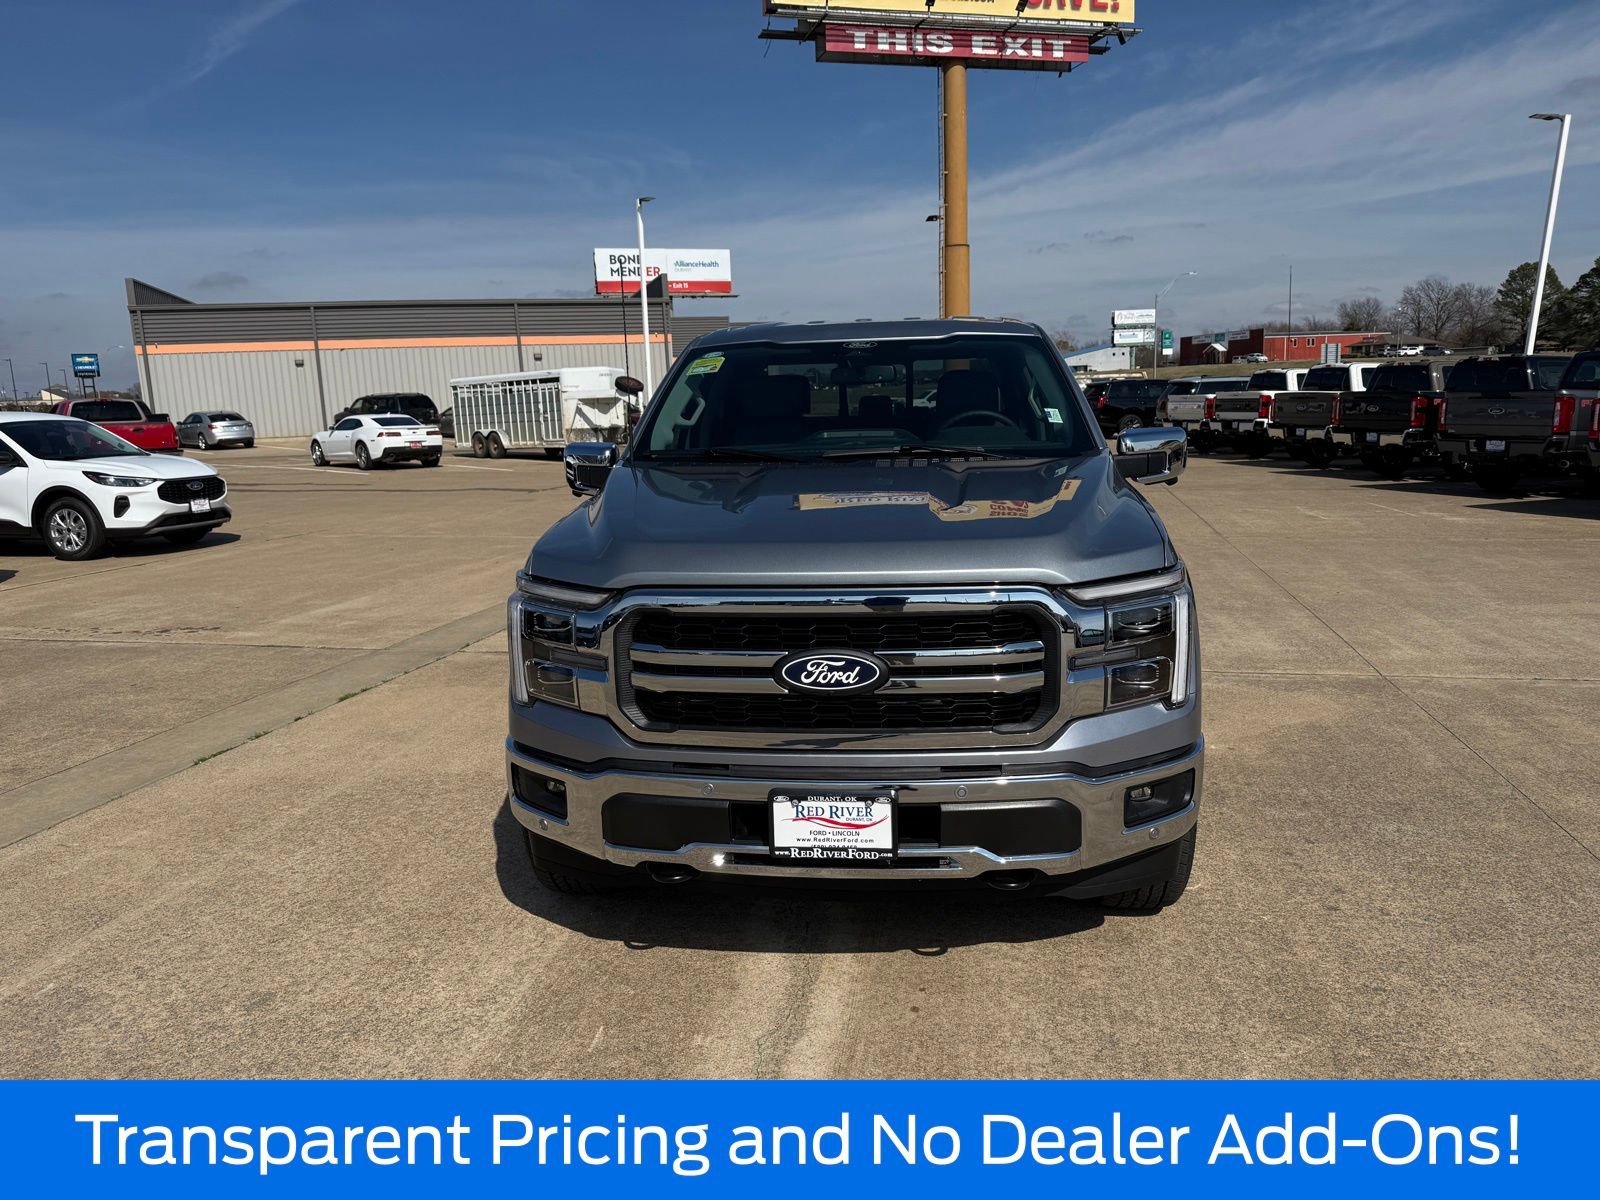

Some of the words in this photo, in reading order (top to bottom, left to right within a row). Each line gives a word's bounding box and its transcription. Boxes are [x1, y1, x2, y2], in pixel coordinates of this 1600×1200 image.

[845, 29, 954, 53] THIS
[971, 35, 1072, 58] EXIT
[674, 260, 719, 268] AllianceHealth
[801, 659, 861, 684] Ford
[794, 804, 824, 818] RED
[829, 805, 874, 819] RIVER
